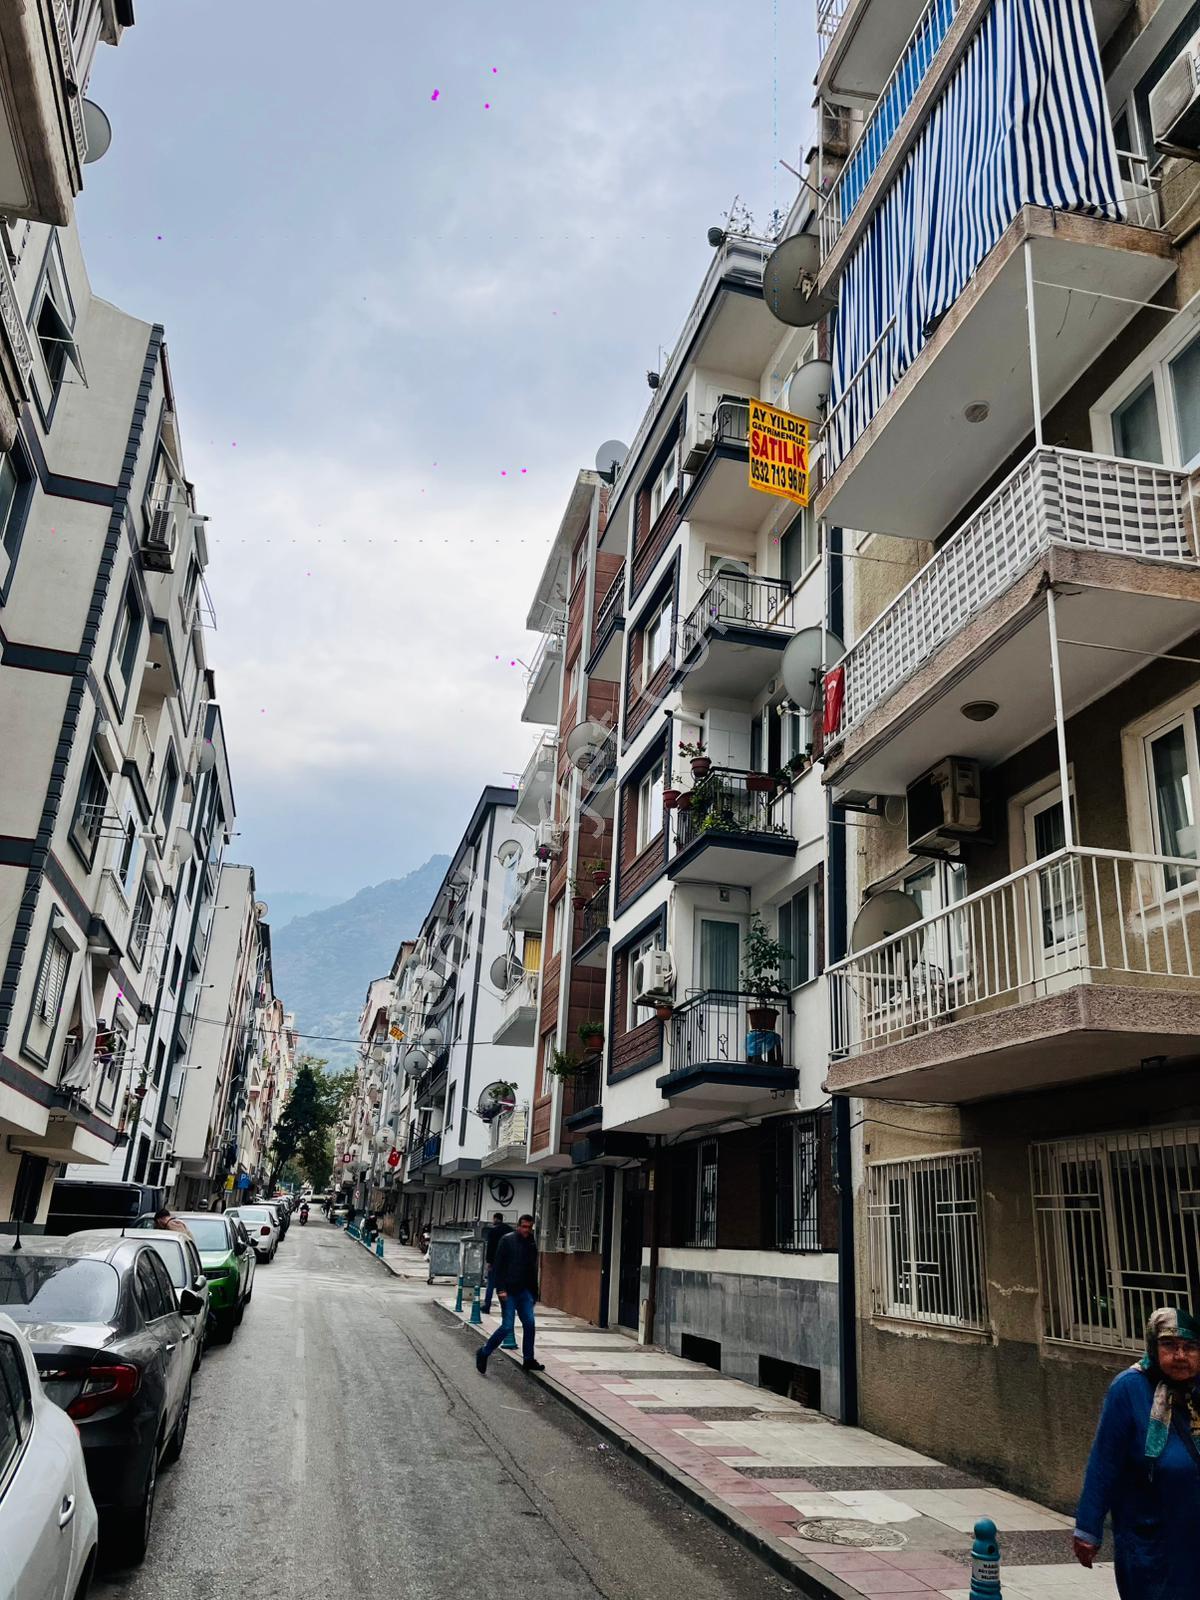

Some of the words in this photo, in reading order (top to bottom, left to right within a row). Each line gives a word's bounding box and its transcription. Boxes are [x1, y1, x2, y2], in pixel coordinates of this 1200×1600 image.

[752, 407, 766, 422] AY
[770, 413, 806, 438] YILDIZ
[752, 421, 806, 447] GAYRİMENKUL
[752, 430, 806, 471] SATILIK
[751, 457, 769, 483] 0532
[771, 463, 786, 488] 713
[788, 466, 806, 495] 9607
